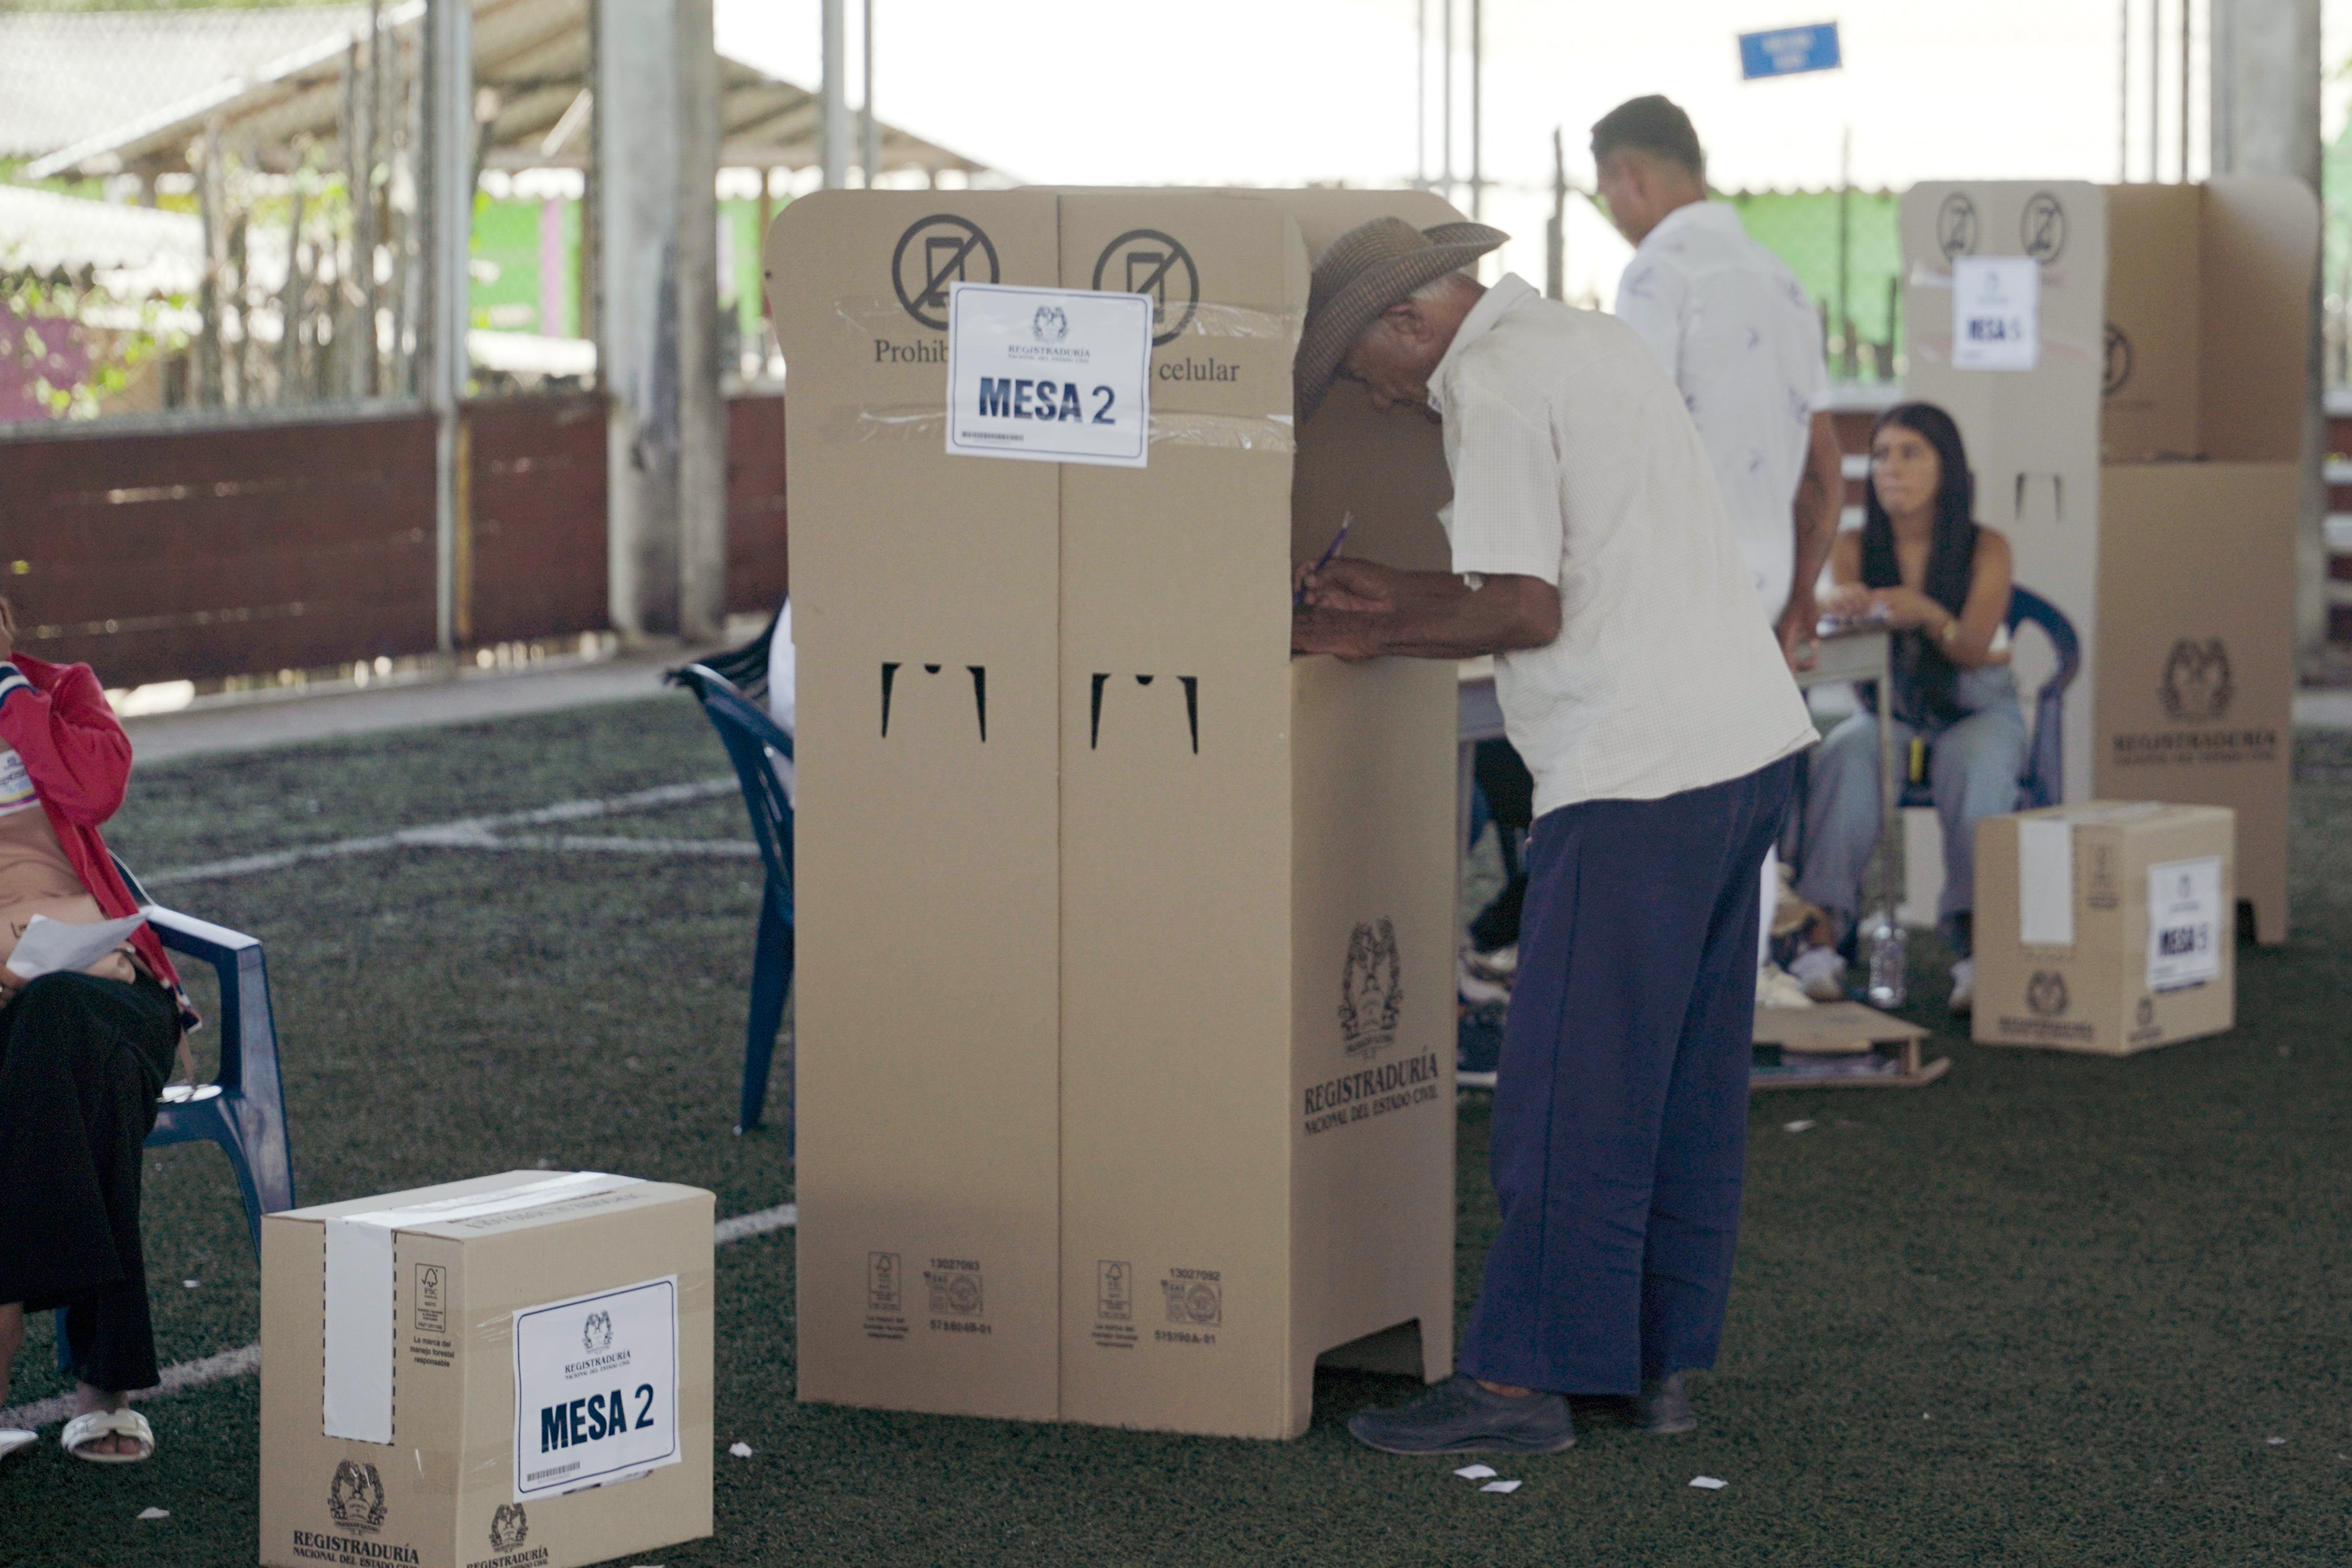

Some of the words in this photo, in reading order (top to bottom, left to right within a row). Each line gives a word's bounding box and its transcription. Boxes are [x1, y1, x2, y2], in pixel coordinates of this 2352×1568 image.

[1009, 345, 1091, 357] REGISTRADURÍA
[1159, 357, 1240, 382] celular
[979, 376, 1083, 423] MESA
[1092, 385, 1116, 425] 2
[1304, 1044, 1439, 1115] REGISTRADURÍA
[410, 1345, 431, 1357] manejo
[433, 1348, 455, 1359] forestal
[422, 1338, 440, 1346] marca
[414, 1356, 451, 1367] responsable
[565, 1348, 631, 1374] REGISTRADURÍA
[541, 1389, 627, 1454] MESA
[634, 1383, 654, 1430] 2
[293, 1529, 420, 1565] REGISTRADURÍA
[293, 1546, 336, 1562] NACIONAL
[339, 1553, 357, 1565] DEL
